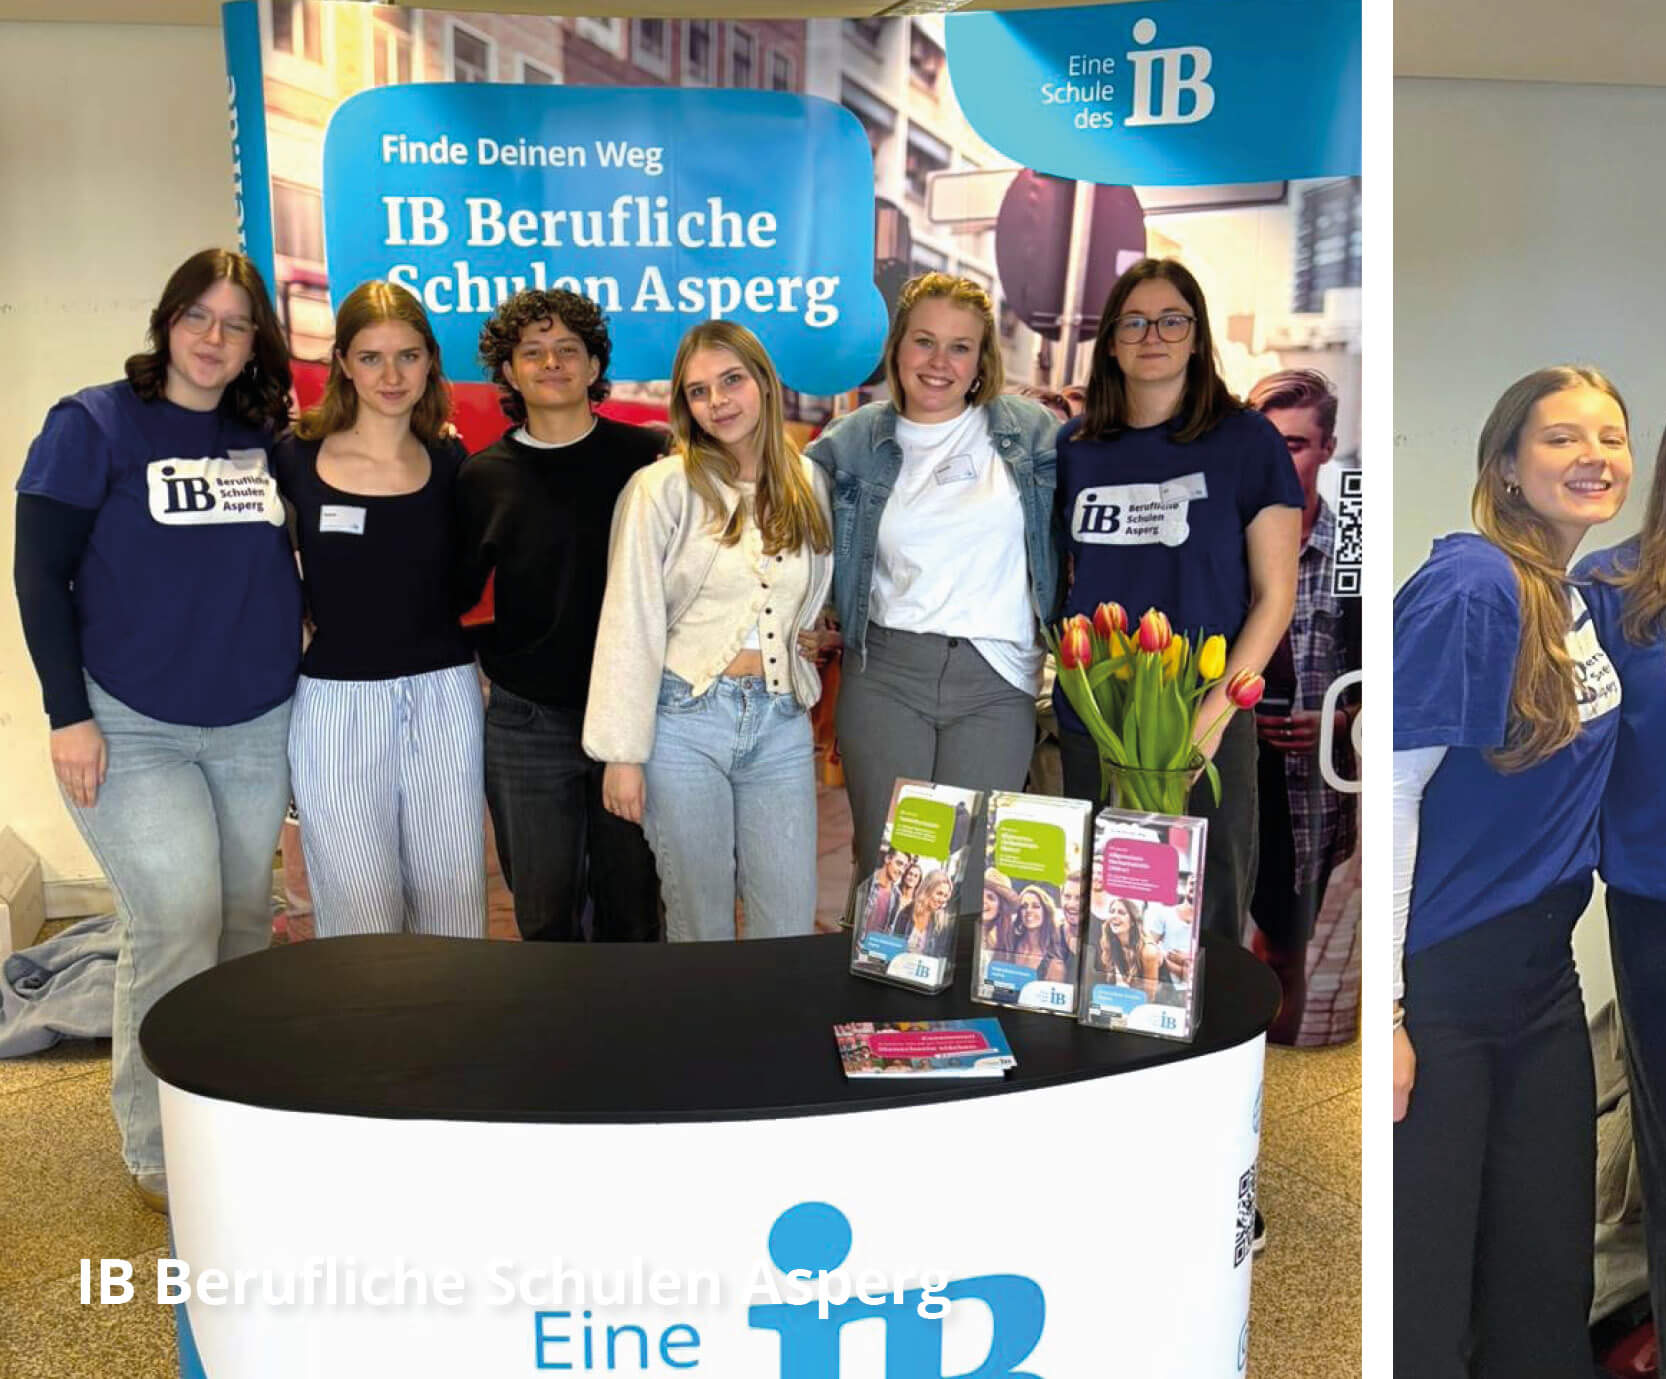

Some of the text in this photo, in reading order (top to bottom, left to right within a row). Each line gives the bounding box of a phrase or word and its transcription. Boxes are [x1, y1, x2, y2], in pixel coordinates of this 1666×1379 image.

[1069, 54, 1115, 77] Eine
[1041, 81, 1115, 105] Schule
[1074, 107, 1114, 129] des
[381, 134, 664, 176] Finde Deinen Weg
[382, 195, 777, 248] IB Berufliche
[630, 265, 841, 328] Asperg
[533, 1309, 701, 1370] Eine
